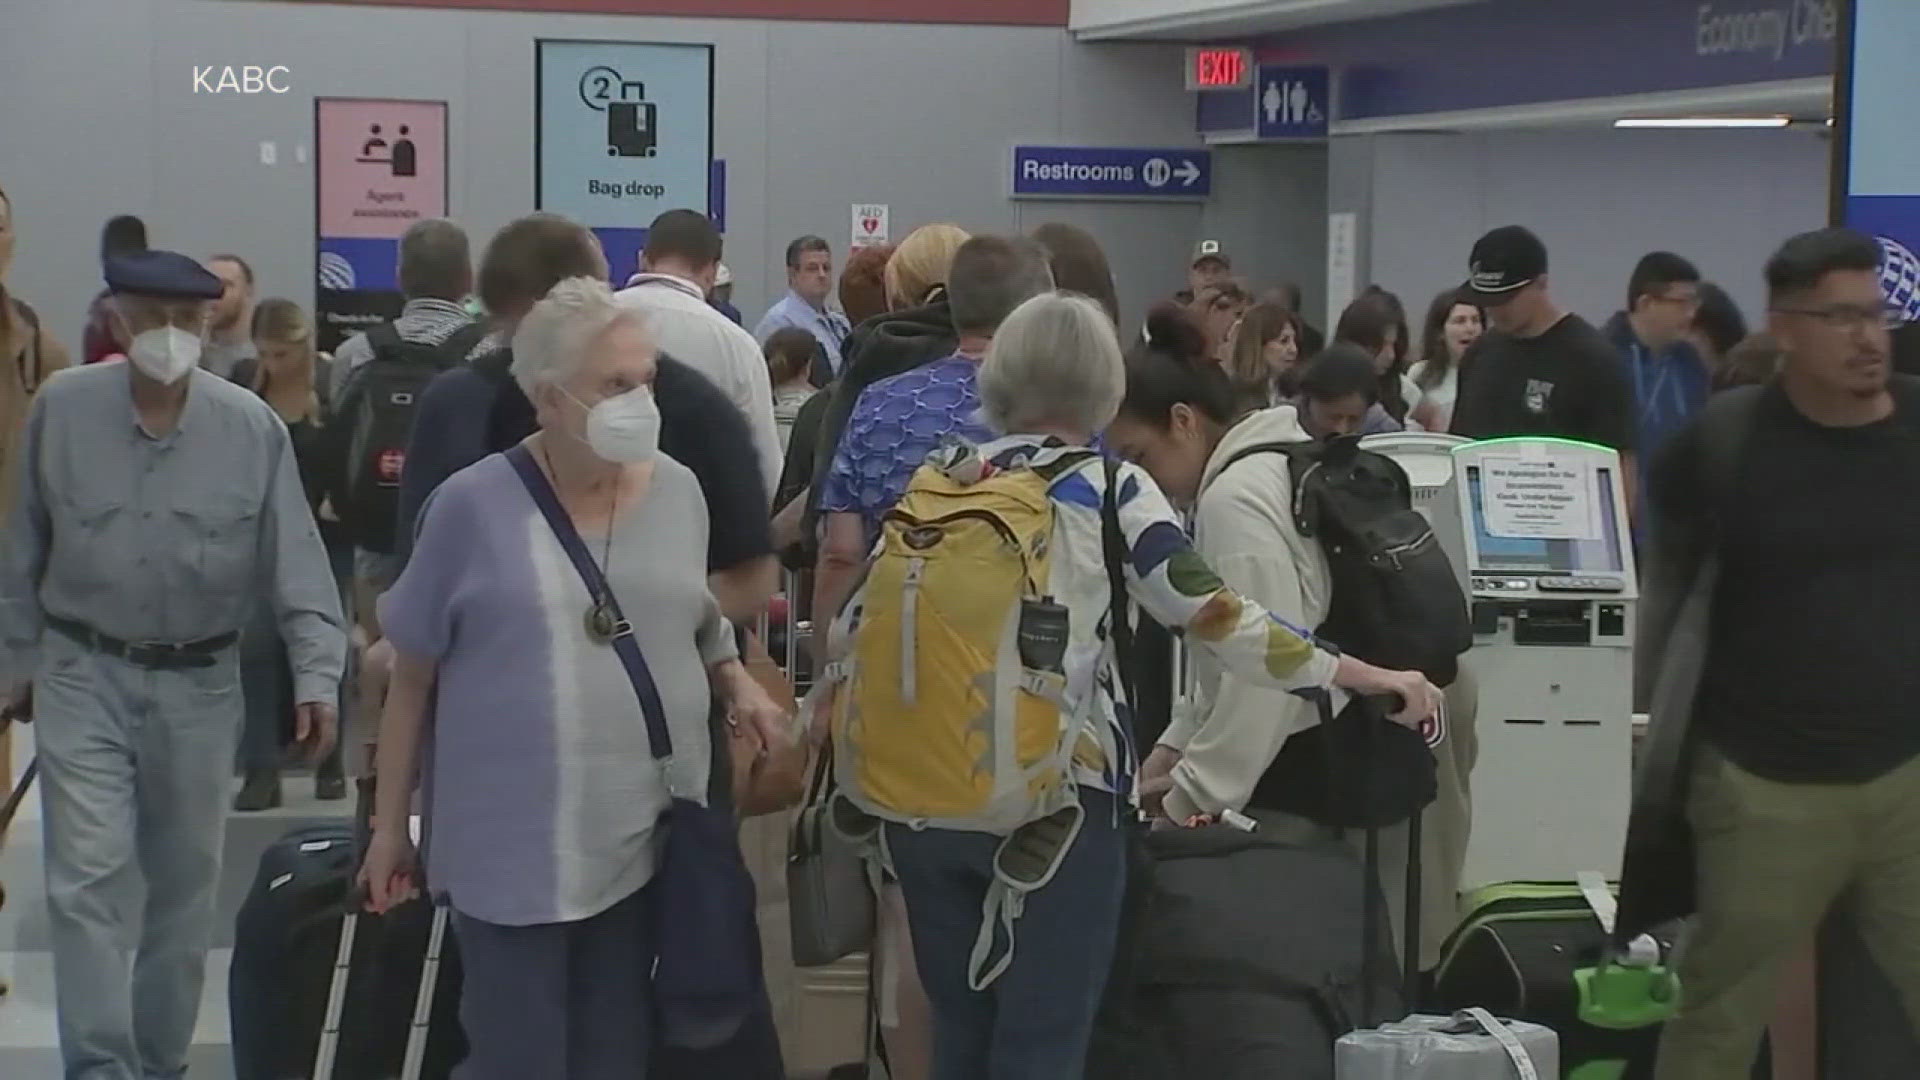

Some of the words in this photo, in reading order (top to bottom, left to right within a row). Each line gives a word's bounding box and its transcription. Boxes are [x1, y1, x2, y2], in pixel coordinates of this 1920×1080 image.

[1696, 4, 1789, 61] Economy
[1199, 51, 1241, 85] EXIT
[593, 77, 610, 100] 2
[1023, 159, 1134, 182] Restrooms
[588, 179, 622, 199] Bag
[625, 180, 665, 199] drop
[860, 207, 883, 217] AED
